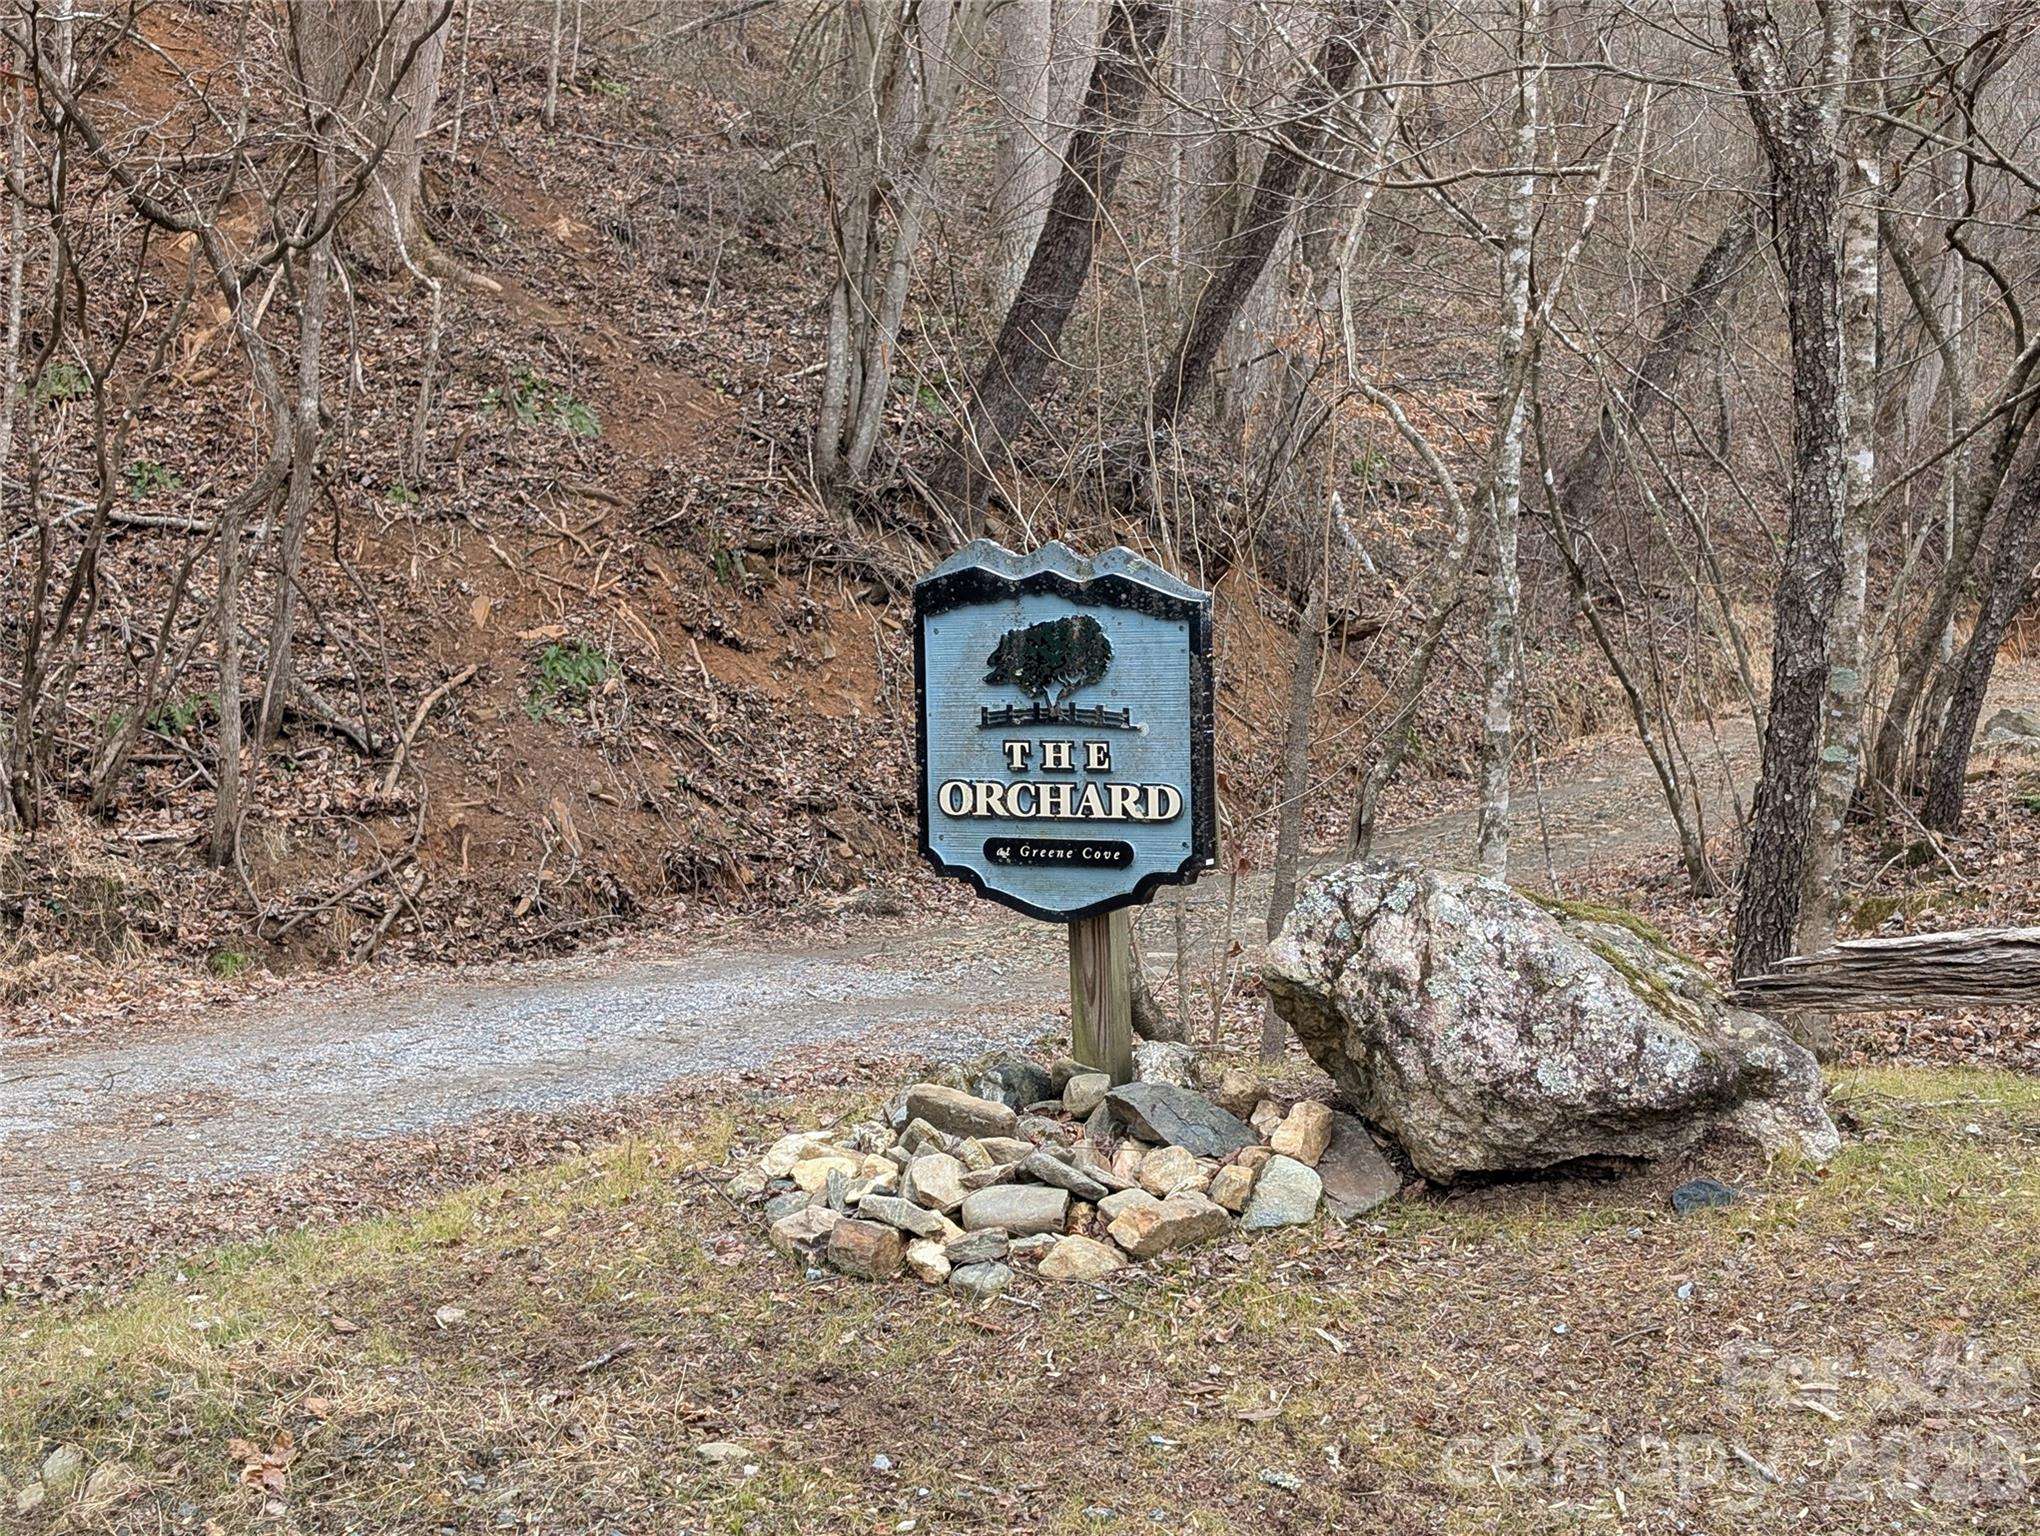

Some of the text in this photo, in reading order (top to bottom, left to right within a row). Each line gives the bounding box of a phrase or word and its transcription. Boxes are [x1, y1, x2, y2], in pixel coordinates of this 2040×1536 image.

[1004, 740, 1111, 772] THE
[938, 780, 1182, 821] ORCHARD
[996, 845, 1121, 860] at Greene Cove
